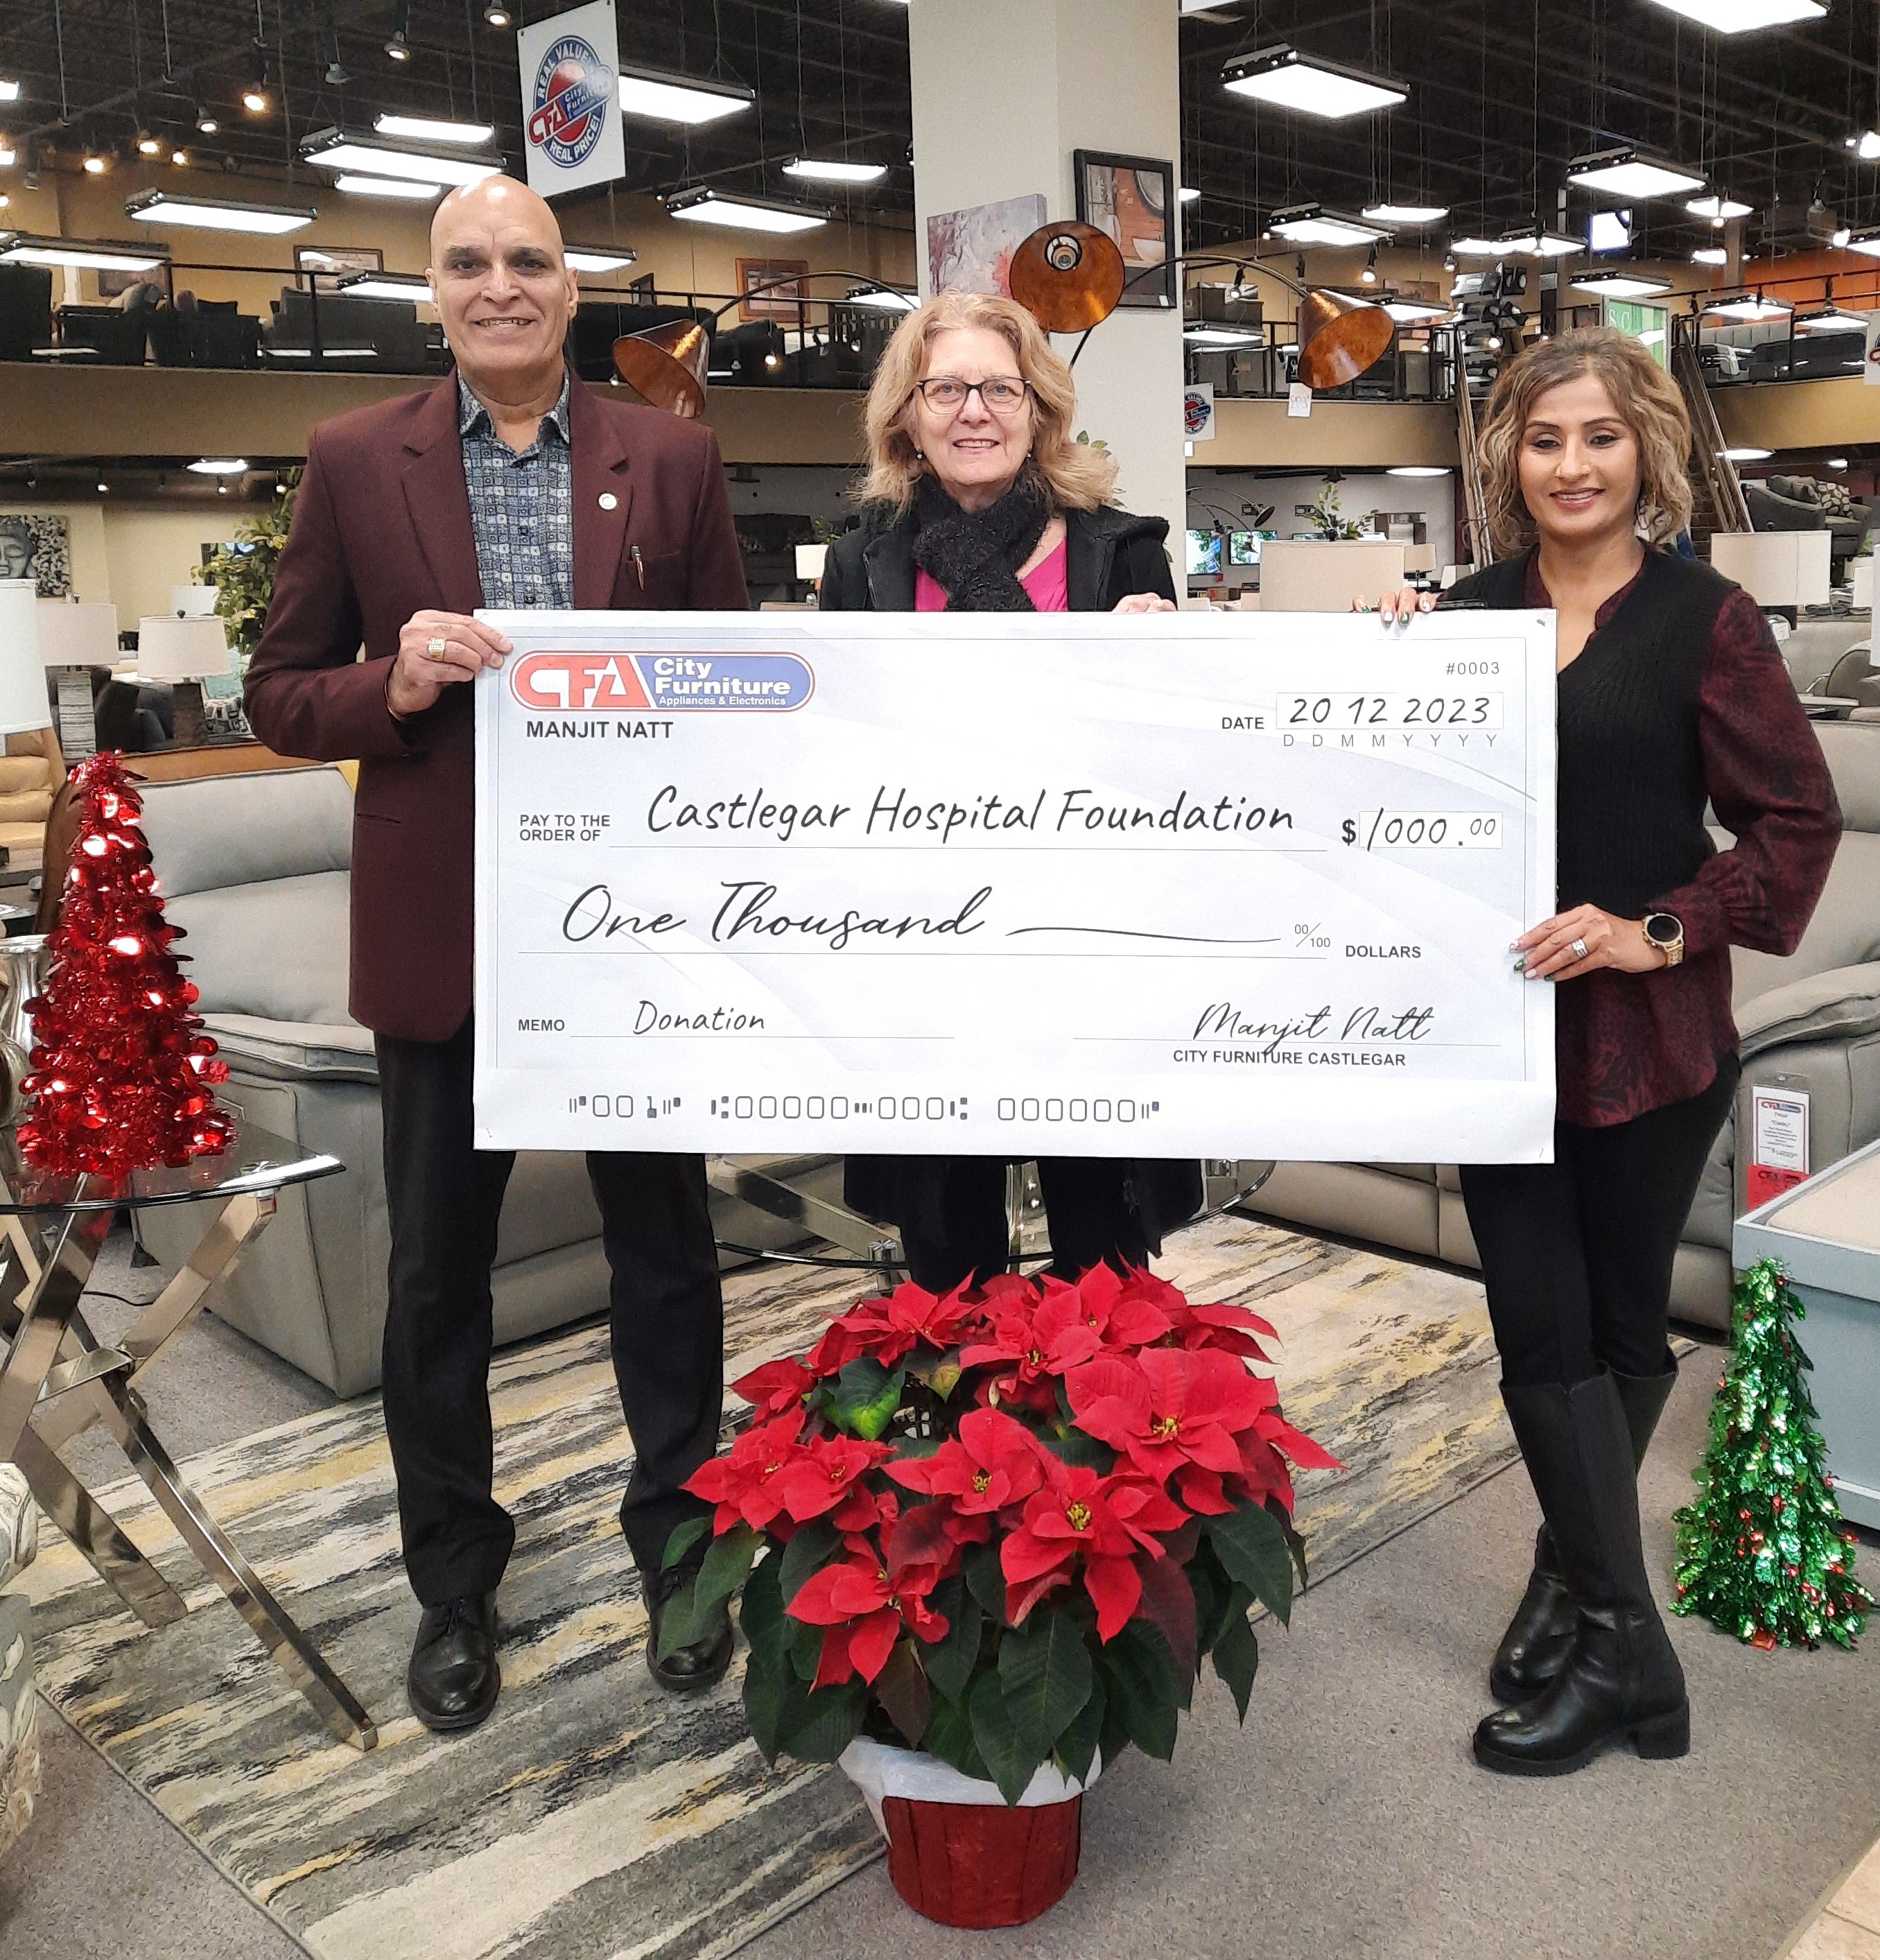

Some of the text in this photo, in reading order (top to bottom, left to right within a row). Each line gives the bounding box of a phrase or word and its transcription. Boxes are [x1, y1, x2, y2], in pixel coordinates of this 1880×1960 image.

[537, 58, 556, 99] REAL
[564, 86, 582, 102] City
[528, 101, 568, 144] CFA
[549, 114, 602, 162] REAL PRICE!
[653, 657, 712, 679] City
[1445, 661, 1501, 676] #0003
[514, 654, 652, 708] CFA
[654, 677, 791, 695] Furniture
[659, 695, 787, 706] Appliances & Electronics
[1222, 697, 1490, 730] DATE 20 12 2023
[528, 722, 674, 739] MANJIT NATT
[521, 815, 611, 828] PAY TO THE
[648, 786, 1294, 844] Castlegar Hospital Foundation
[520, 829, 602, 842] ORDER OF
[564, 882, 993, 951] One Thousand
[1346, 946, 1422, 959] DOLLARS
[519, 1000, 765, 1036] MEMO Donation
[1192, 1002, 1434, 1055] Manjit Natt
[1174, 1050, 1407, 1067] CITY FURNITURE CASTLEGAR
